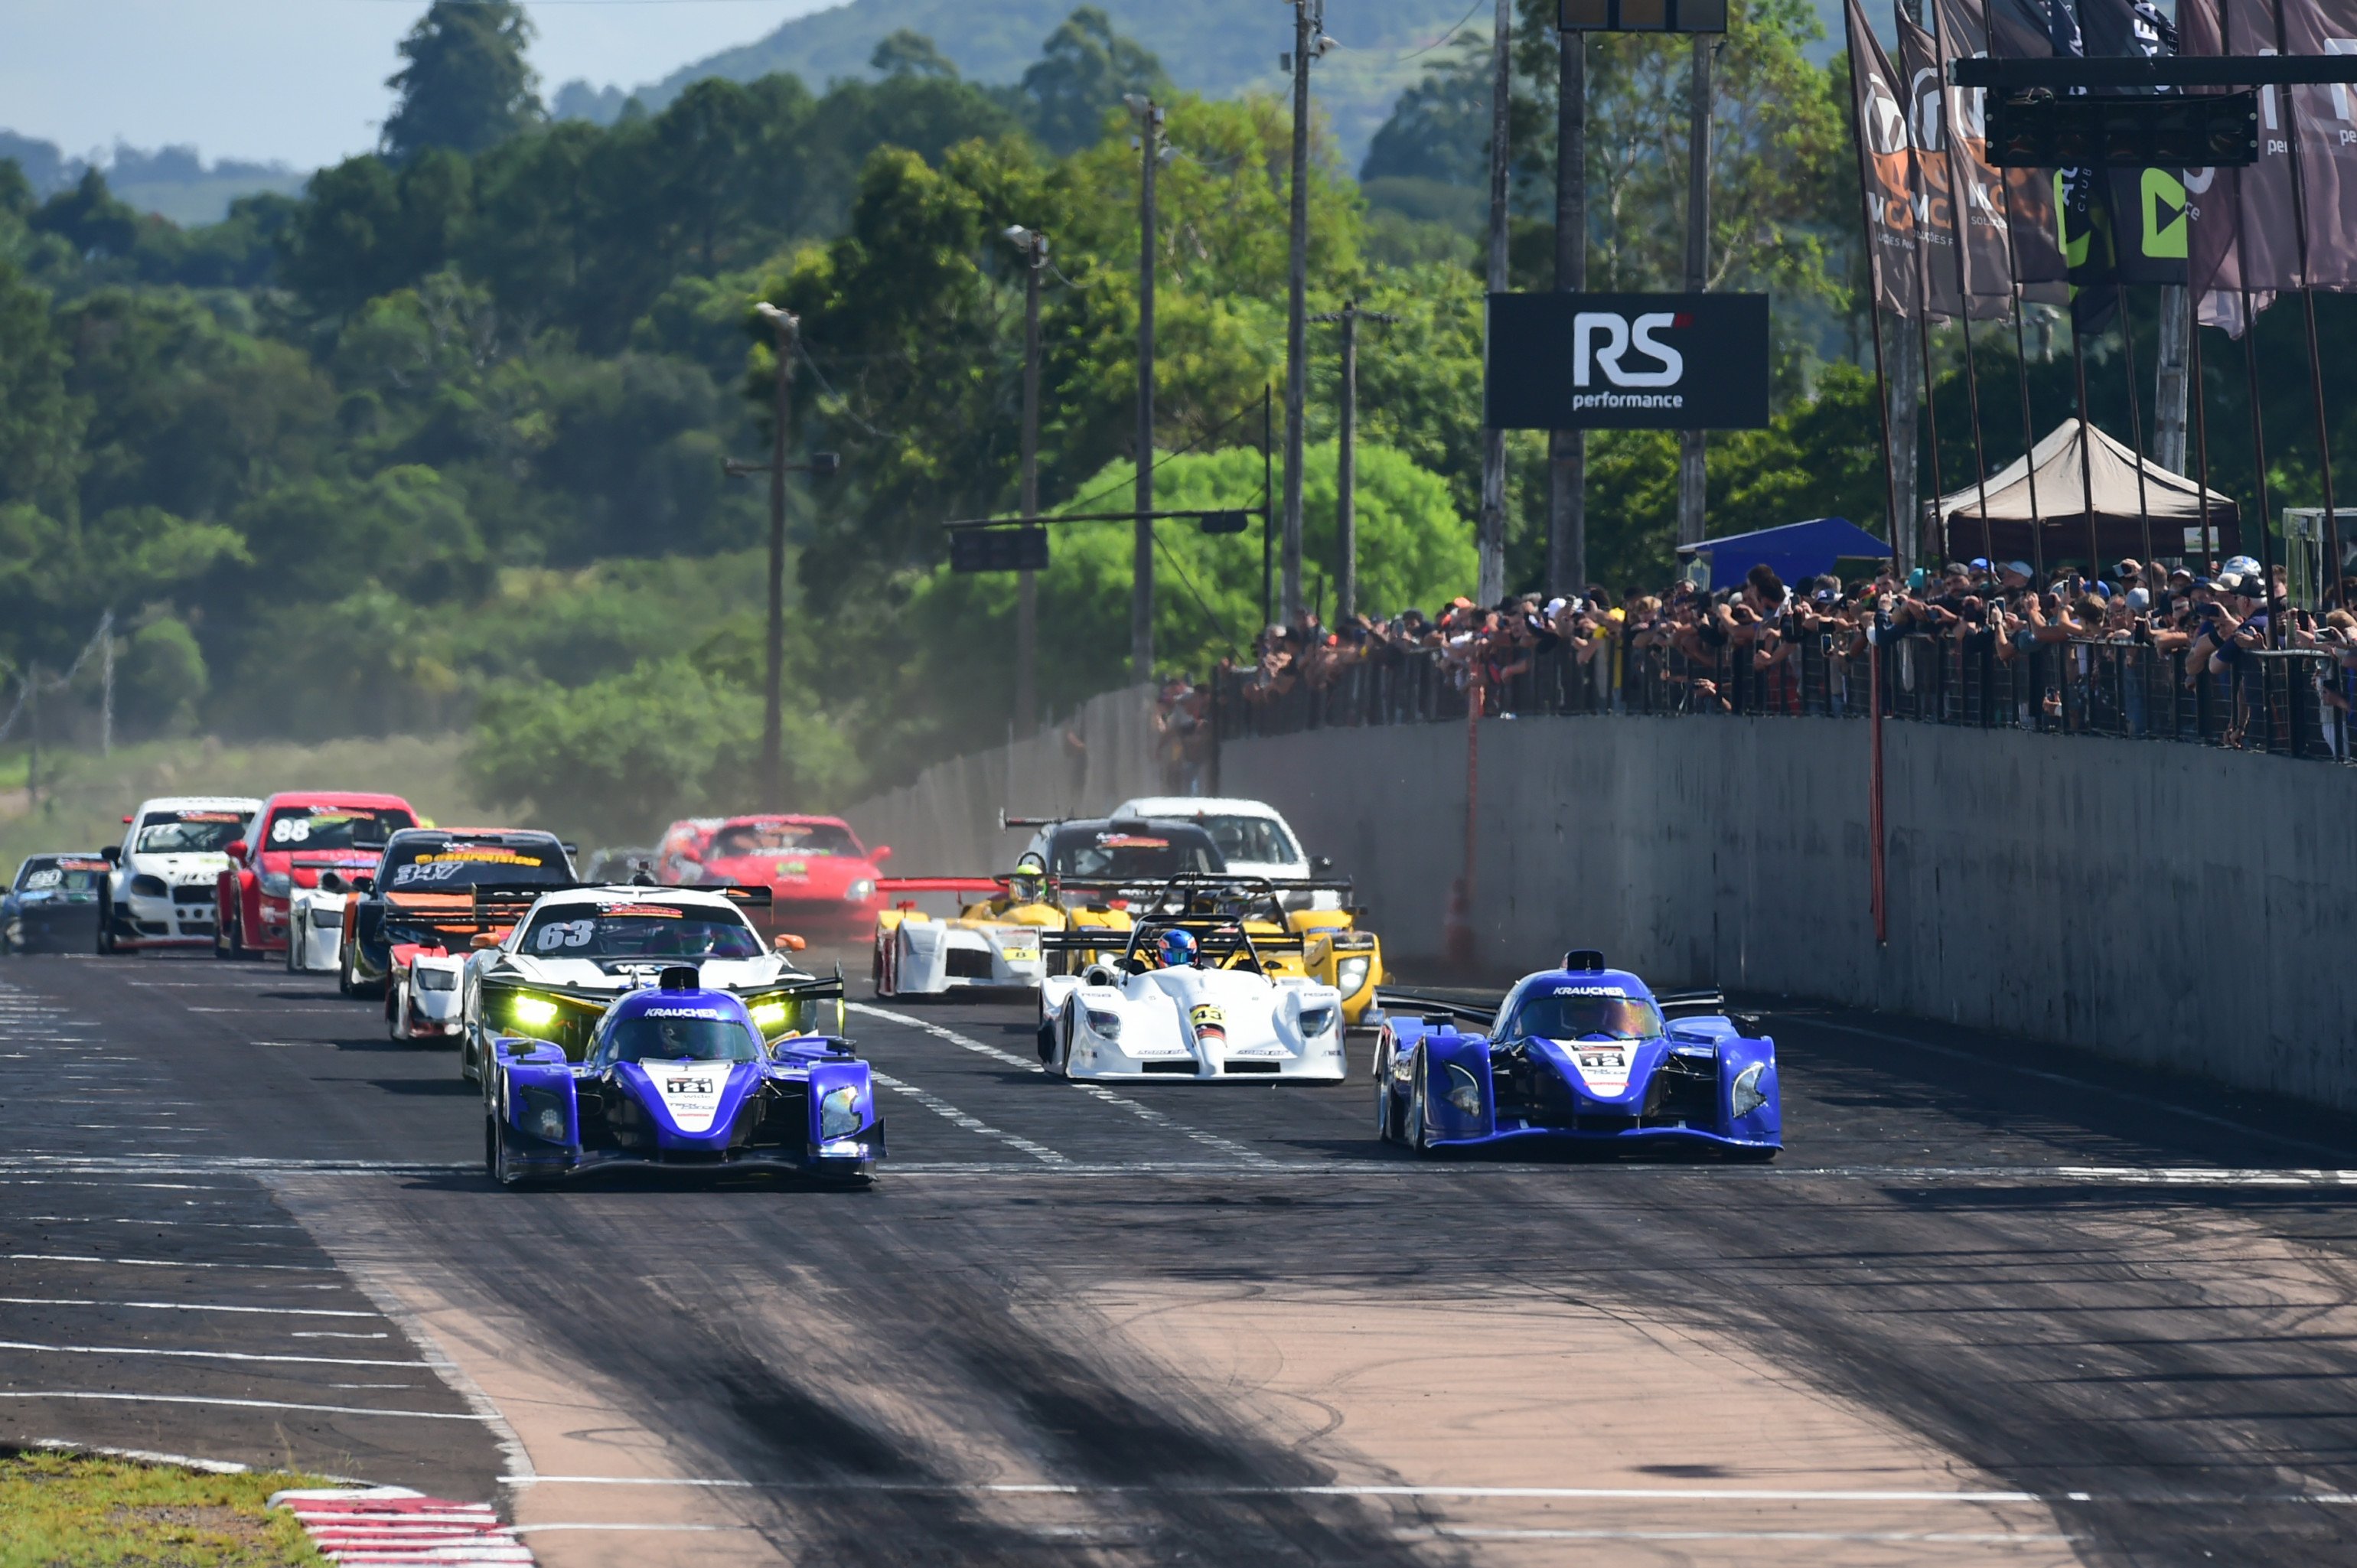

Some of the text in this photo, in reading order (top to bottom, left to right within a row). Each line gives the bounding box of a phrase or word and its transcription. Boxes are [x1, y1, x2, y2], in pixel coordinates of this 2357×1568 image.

[2077, 168, 2092, 212] CLUB
[1573, 311, 1684, 387] RS
[1573, 390, 1684, 411] performance
[272, 819, 310, 842] 88
[393, 862, 464, 886] 347
[537, 920, 594, 950] 63
[1553, 986, 1626, 996] KRAUCHER
[644, 1008, 719, 1018] KRAUCHER
[1194, 1011, 1222, 1021] 43
[1586, 1057, 1620, 1067] 12
[668, 1081, 712, 1093] 121
